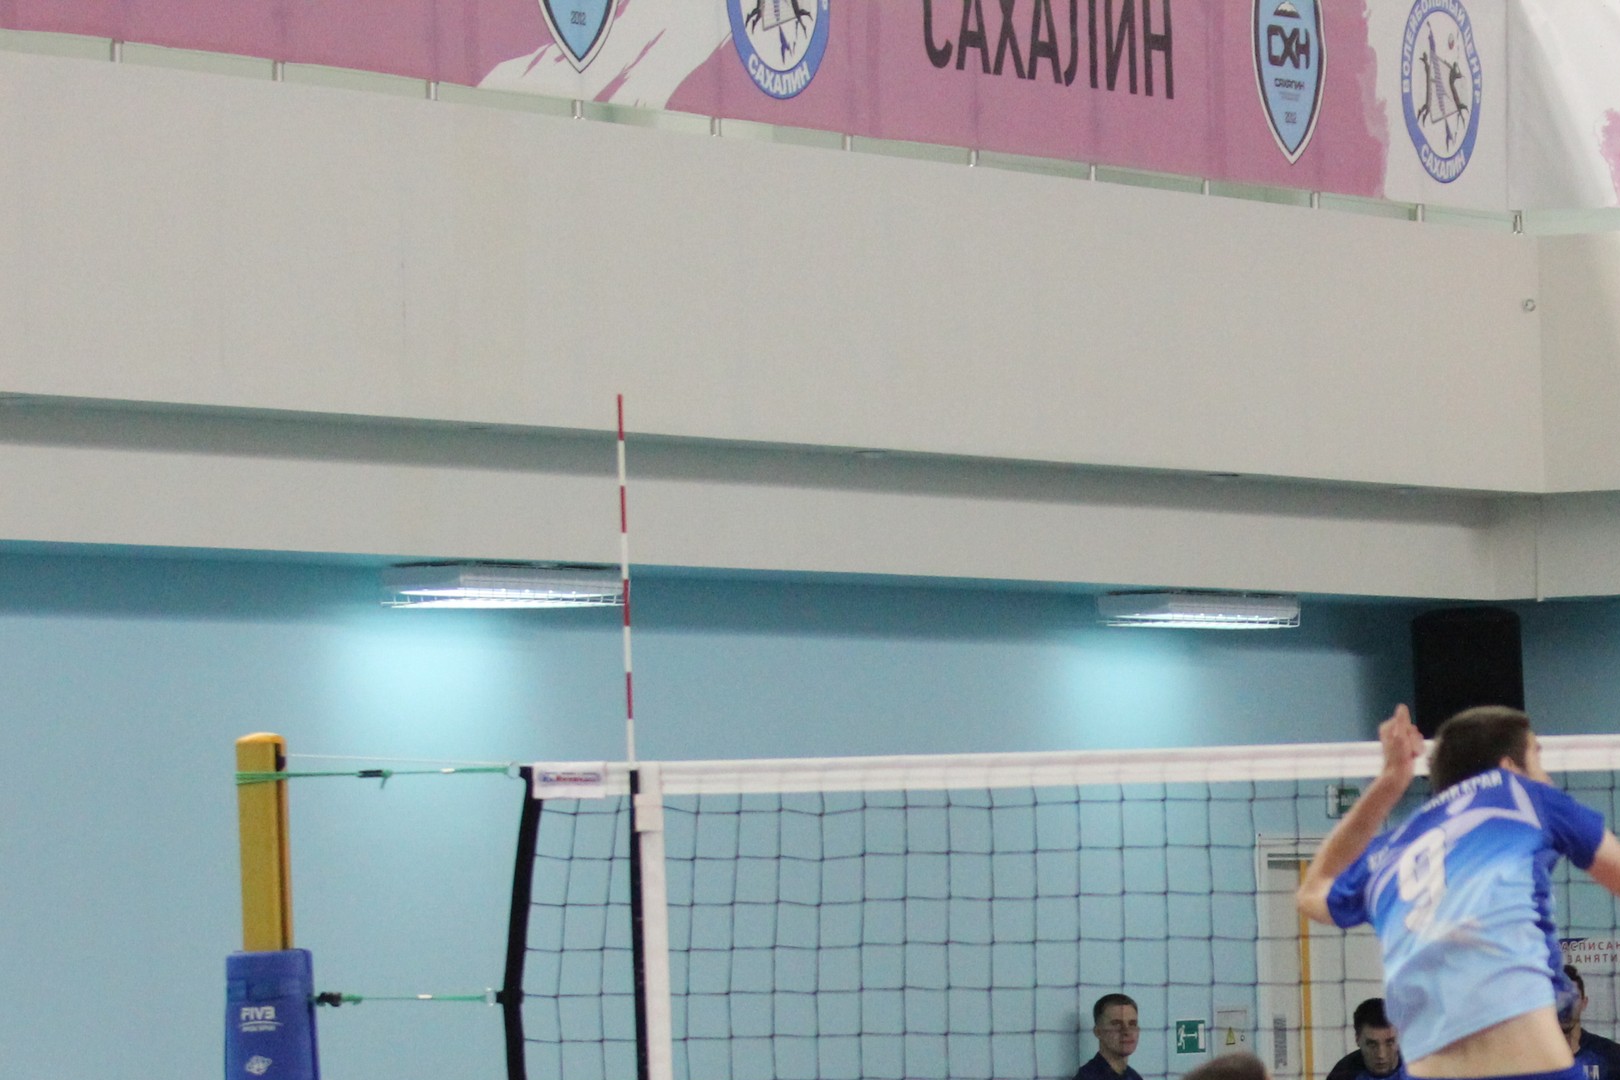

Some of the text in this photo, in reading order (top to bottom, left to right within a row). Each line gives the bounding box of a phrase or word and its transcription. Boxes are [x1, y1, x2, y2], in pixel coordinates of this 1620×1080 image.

[749, 53, 811, 96] САХАЛИН
[923, 0, 1175, 100] САХАЛИН
[1399, 827, 1446, 932] 9
